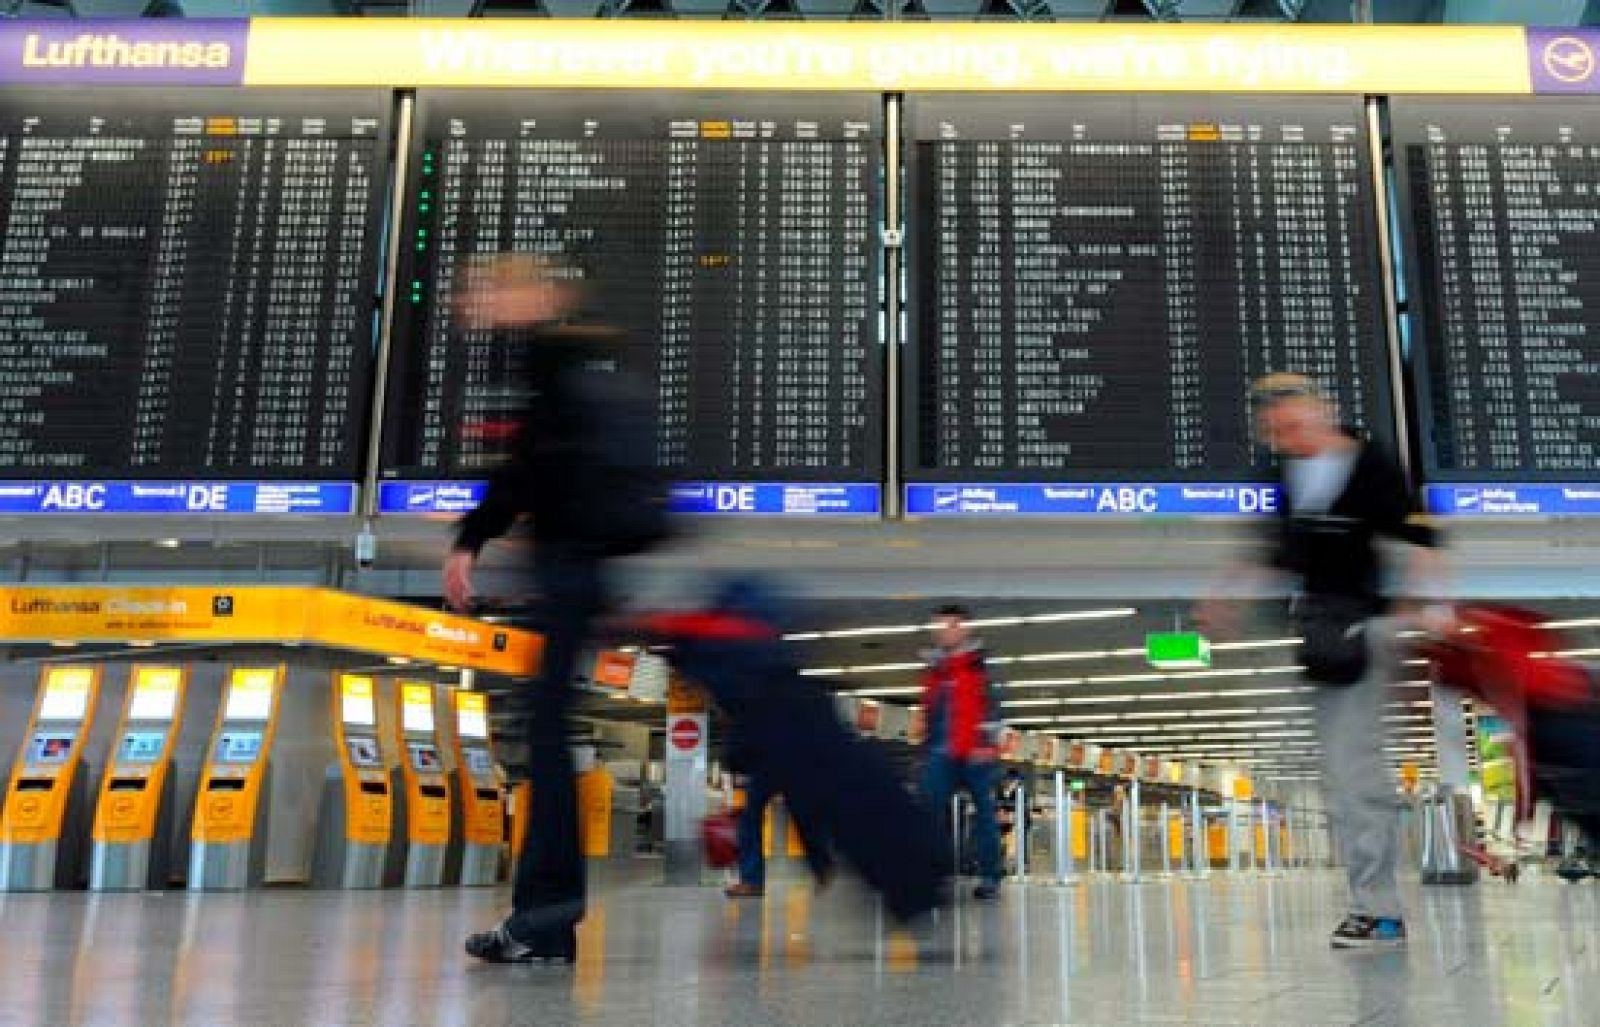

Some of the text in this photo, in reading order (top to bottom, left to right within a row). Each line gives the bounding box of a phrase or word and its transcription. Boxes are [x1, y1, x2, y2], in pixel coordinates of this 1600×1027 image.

[23, 33, 231, 69] Lufthansa
[418, 28, 666, 72] Wherever
[692, 33, 852, 82] you're
[1052, 33, 1187, 77] we're
[41, 485, 106, 510] ABC
[187, 485, 228, 510] DE
[717, 487, 755, 510] DE
[1097, 487, 1159, 512] ABC
[1238, 488, 1278, 512] DE
[11, 596, 101, 616] Lufthansa
